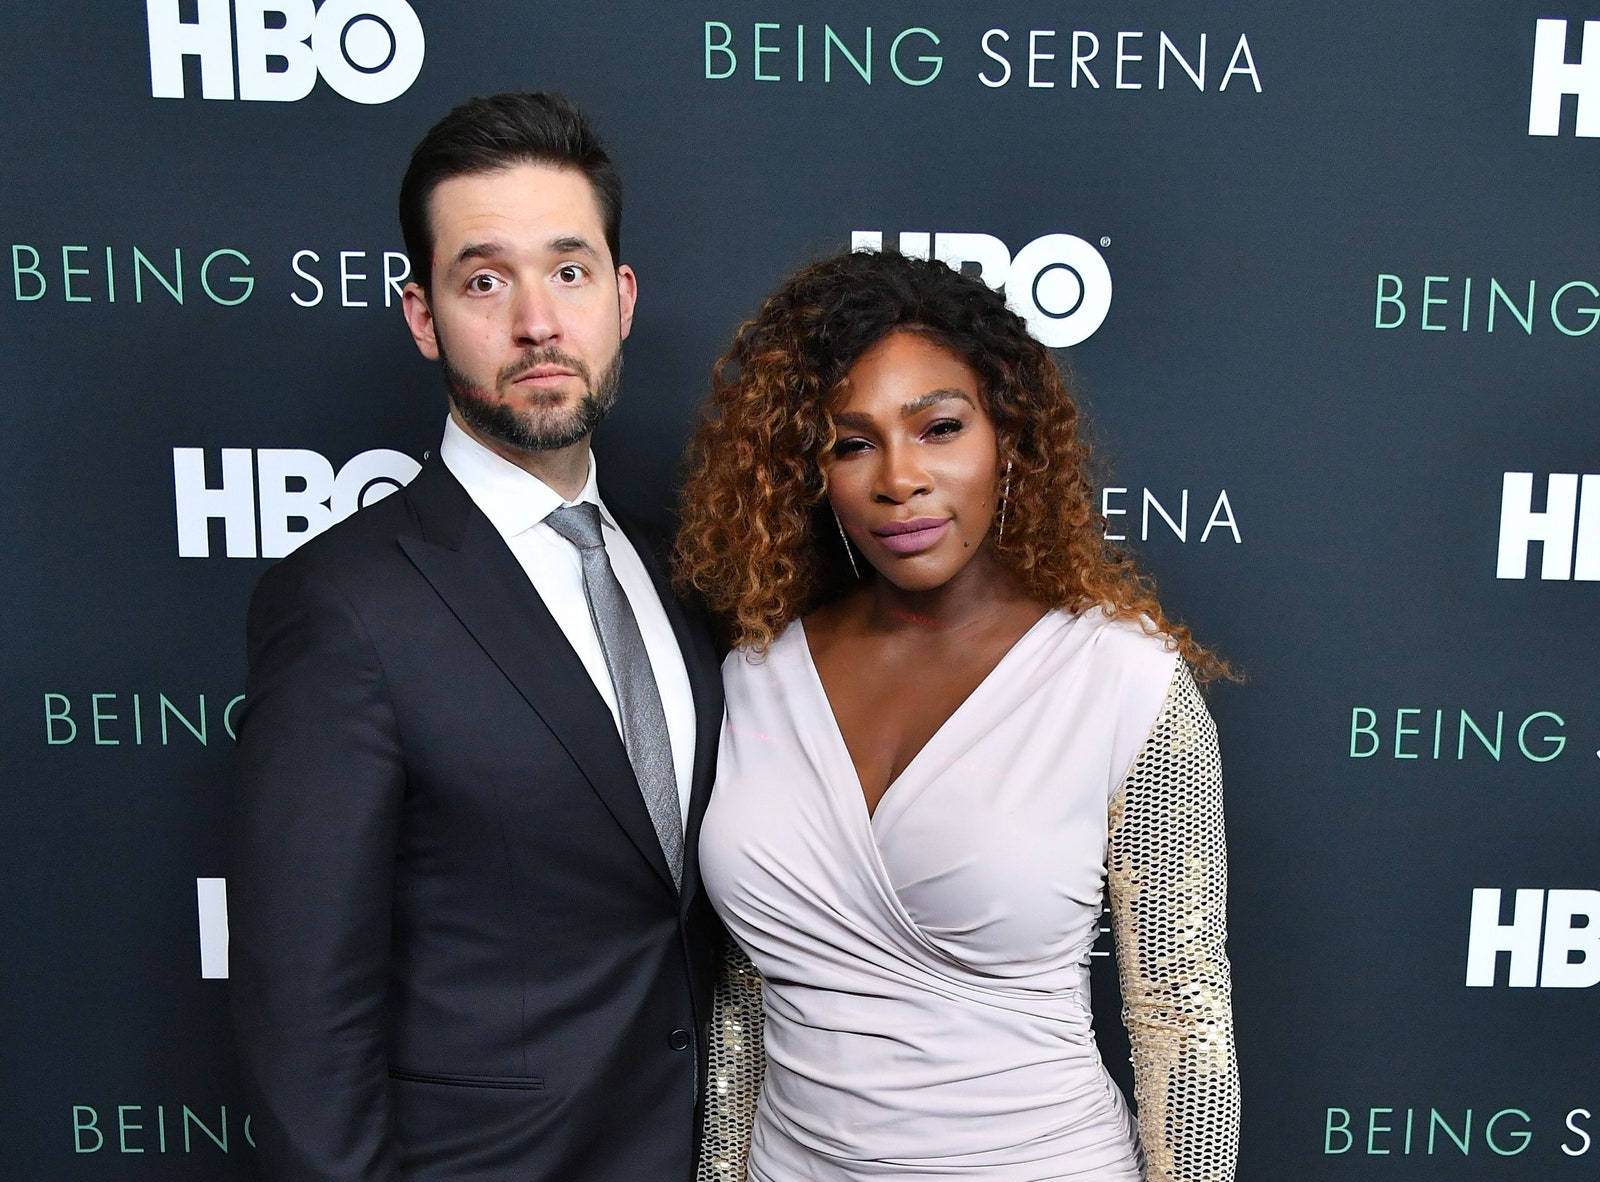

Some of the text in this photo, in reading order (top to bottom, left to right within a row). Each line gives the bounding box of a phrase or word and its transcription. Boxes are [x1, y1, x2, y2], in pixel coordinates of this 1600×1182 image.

[146, 0, 426, 105] HBO
[705, 21, 1263, 93] BEING SERENA
[12, 244, 411, 307] BEING SER
[1376, 274, 1600, 337] BEING
[1496, 471, 1600, 582] H
[1349, 707, 1567, 762] BEING
[72, 1104, 256, 1153] BEIN
[1324, 1107, 1532, 1156] BEING
